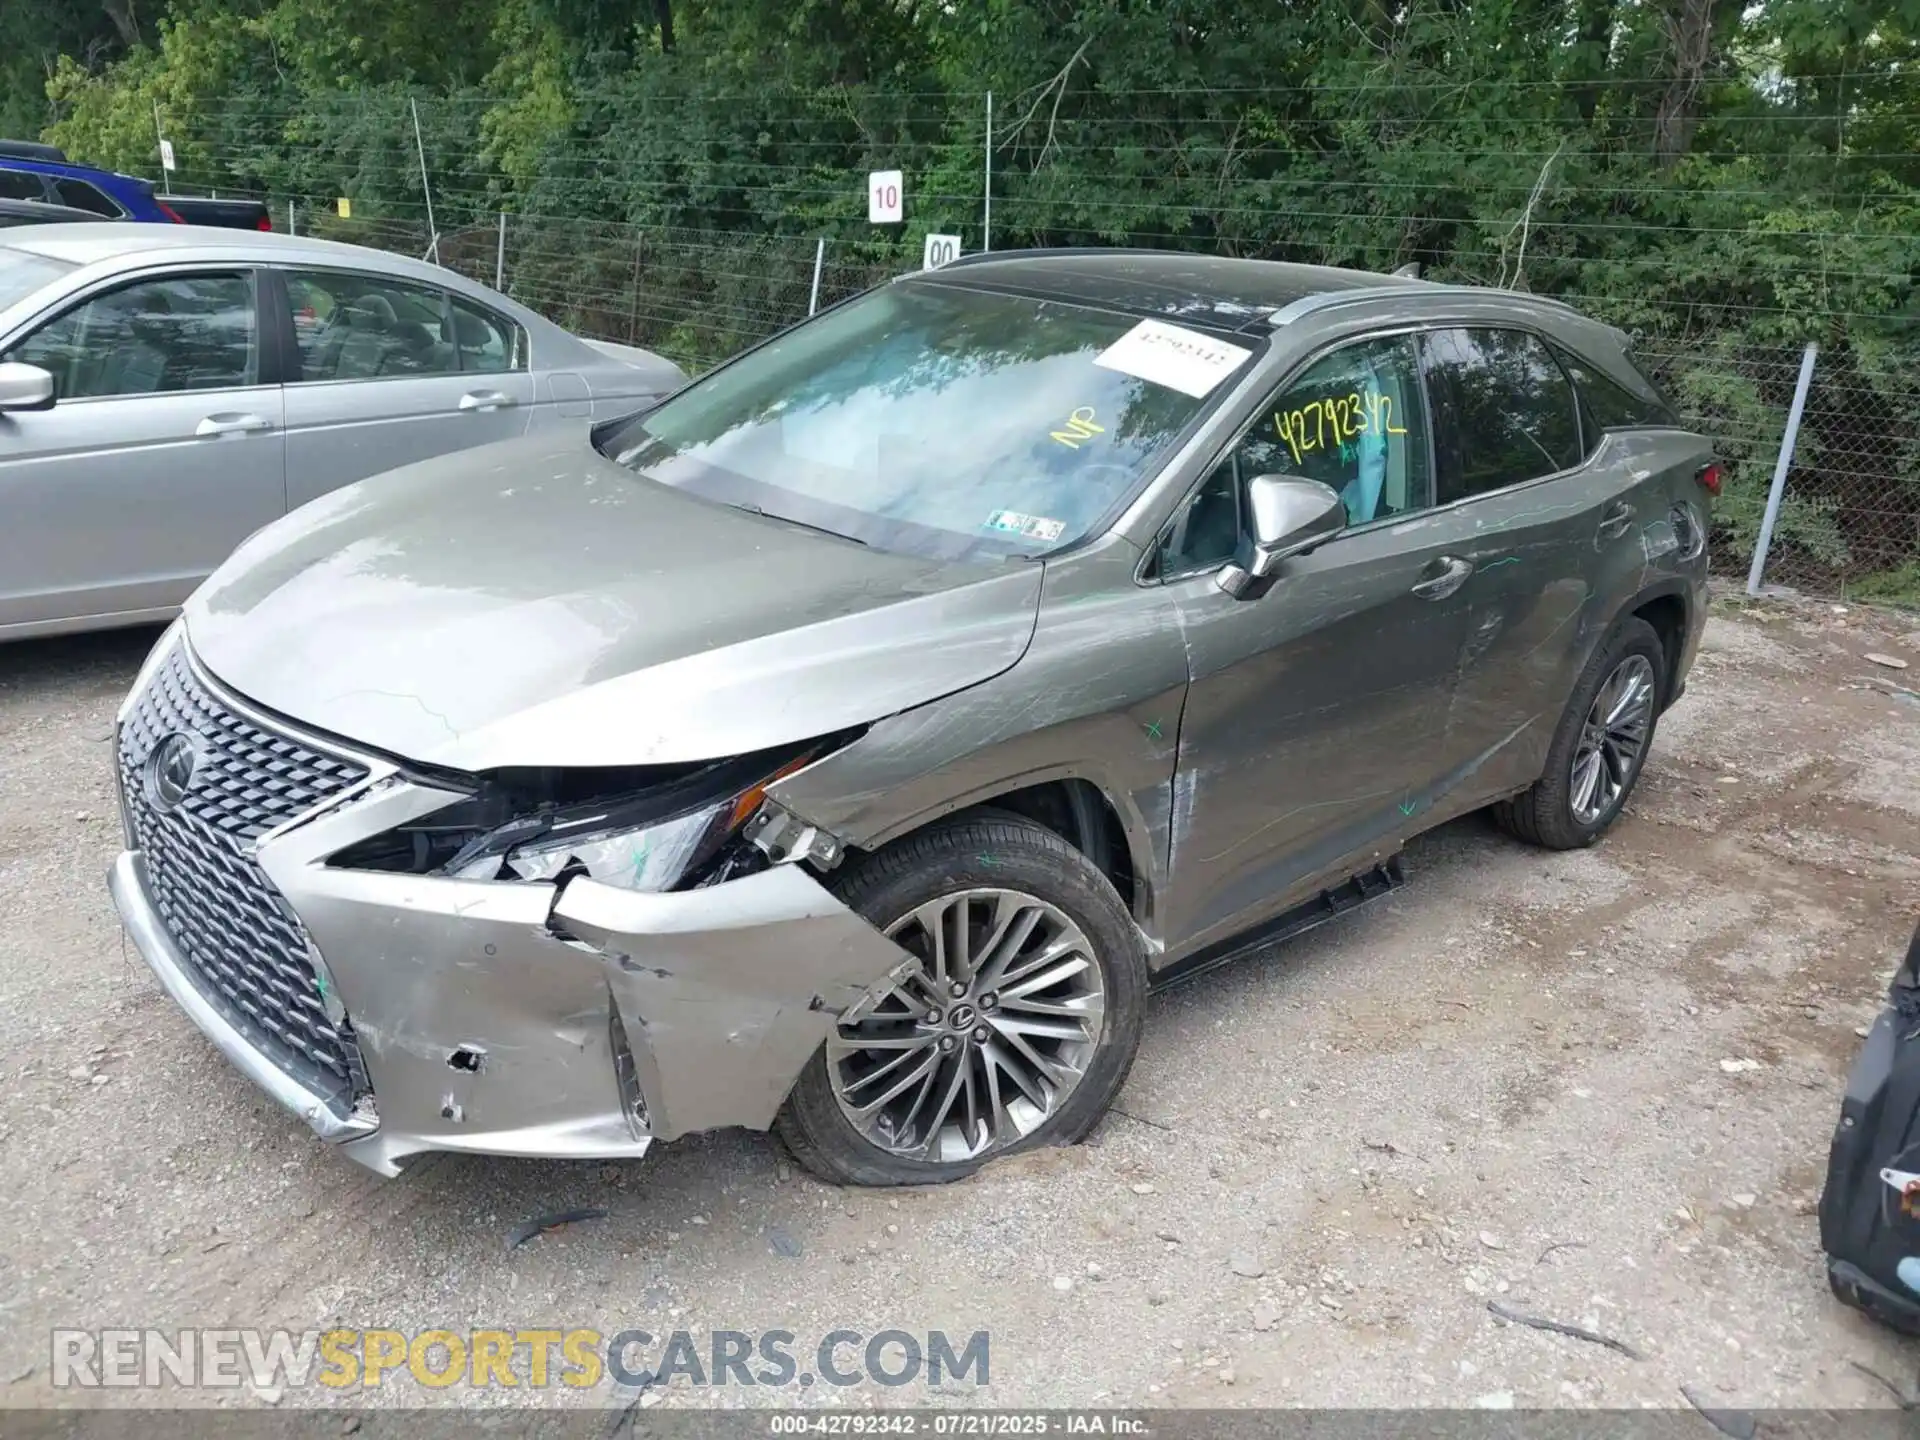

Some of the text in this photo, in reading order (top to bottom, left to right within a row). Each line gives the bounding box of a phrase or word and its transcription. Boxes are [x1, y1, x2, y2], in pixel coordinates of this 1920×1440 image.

[875, 185, 897, 209] 10
[1048, 406, 1105, 449] NP
[1274, 390, 1408, 465] 42792342
